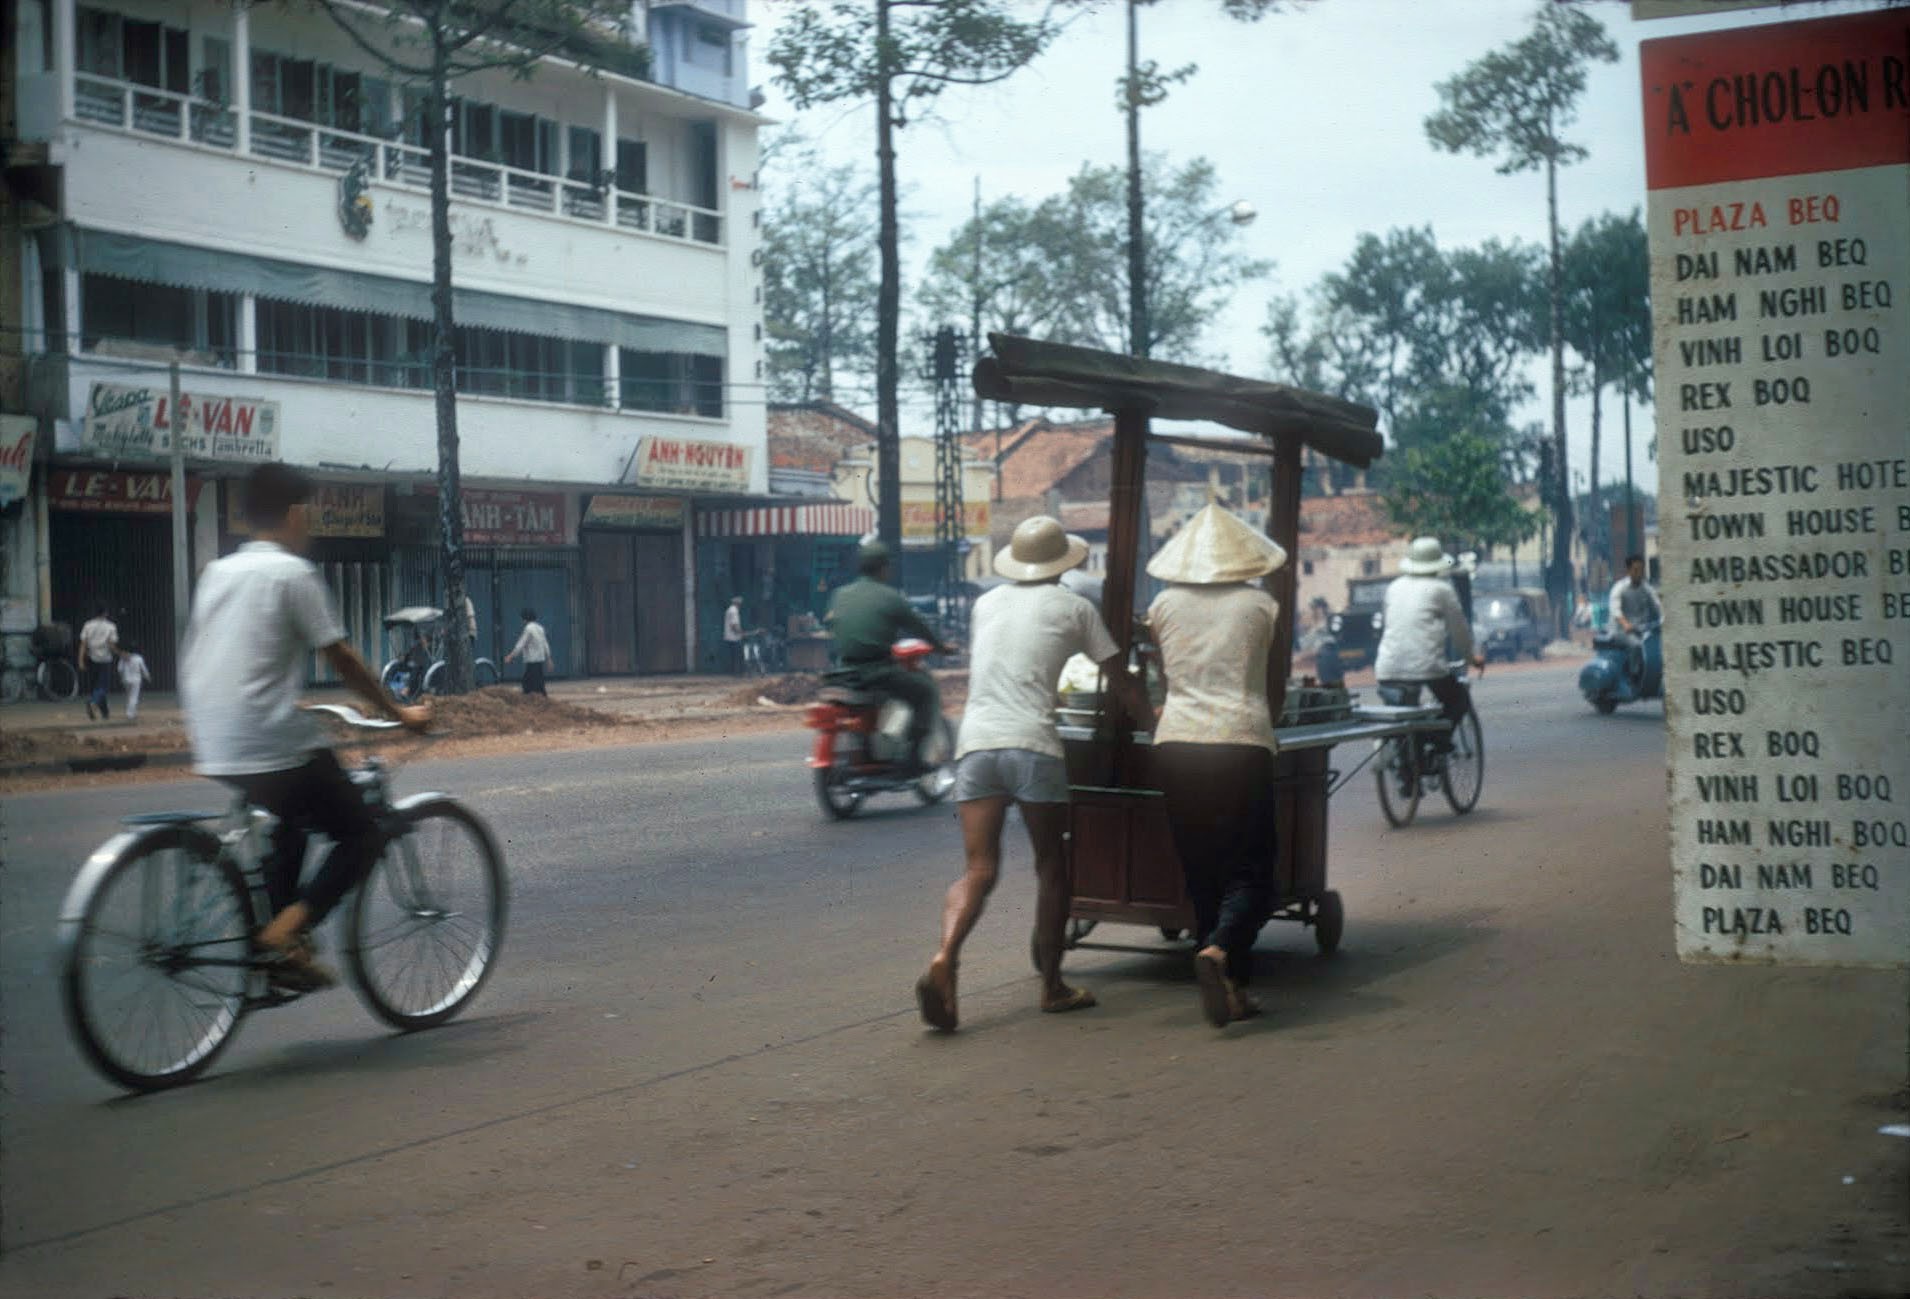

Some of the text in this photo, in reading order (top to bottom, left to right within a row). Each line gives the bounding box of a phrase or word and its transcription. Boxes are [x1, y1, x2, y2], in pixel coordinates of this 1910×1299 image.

[1674, 195, 1840, 236] PLAZA BEQ
[1677, 238, 1867, 281] DAI NAM BEQ
[1678, 280, 1892, 325] HAM NGHI BEQ
[1680, 327, 1880, 367] VINH LOI BOQ
[1681, 377, 1811, 411] REX BOQ
[162, 434, 206, 450] SCHS
[1682, 426, 1734, 455] USO
[1684, 460, 1907, 498] MAJESTIC HOTE
[1688, 513, 1765, 541] TOWN
[1787, 507, 1877, 536] HOUSE
[1690, 551, 1869, 583] AMBASSADOR
[1690, 599, 1764, 628] TOWN
[1780, 594, 1863, 624] HOUSE
[1690, 638, 1893, 671] MAJESTIC BEQ
[1692, 688, 1746, 715] USO
[1694, 731, 1819, 759] REX BOQ
[1696, 774, 1892, 802] VINH LOI BOQ
[1697, 819, 1908, 847] HAM NGHI BOQ
[1700, 863, 1879, 890] DAI NAM BEQ
[1702, 906, 1851, 935] PLAZA BEQ
